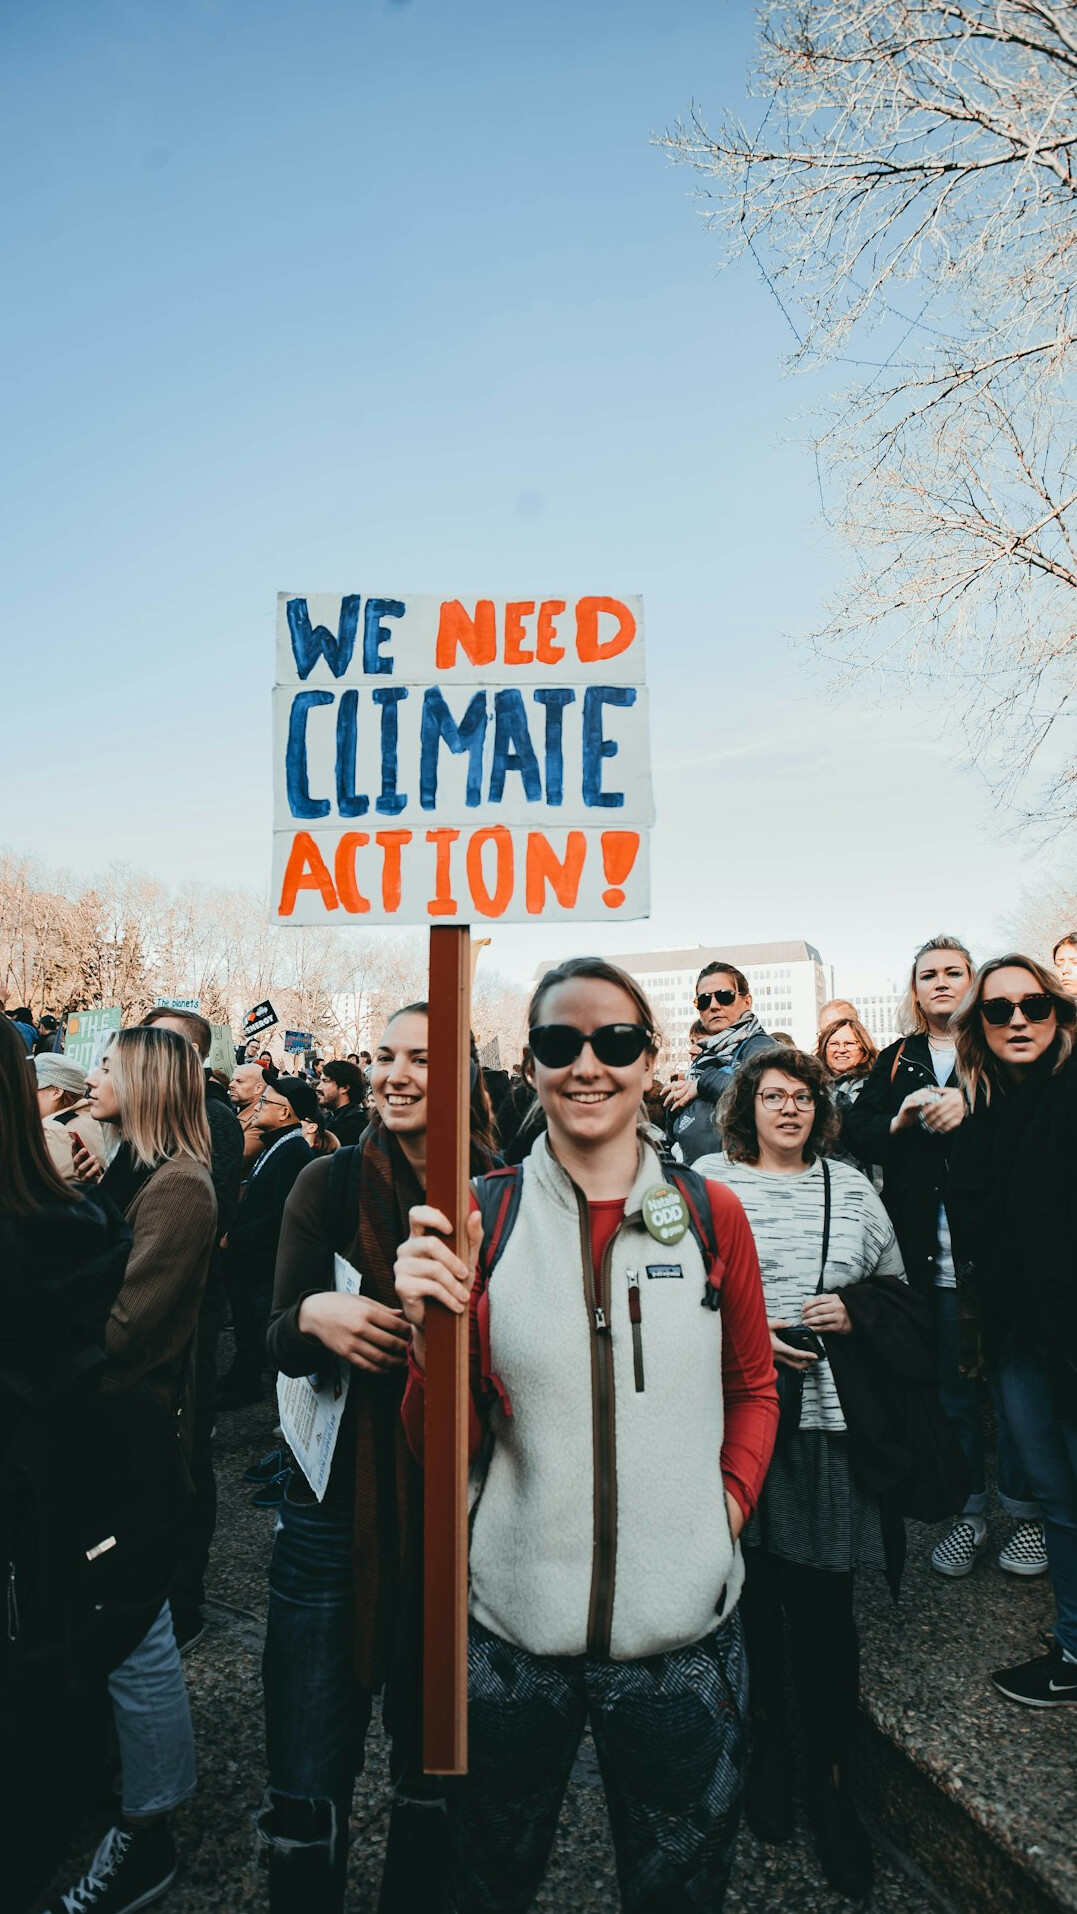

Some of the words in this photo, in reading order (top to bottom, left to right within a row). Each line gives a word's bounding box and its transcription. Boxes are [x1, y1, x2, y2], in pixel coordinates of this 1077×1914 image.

[286, 594, 406, 680] WE
[436, 596, 636, 669] NEED
[286, 685, 637, 819] CLIMATE
[278, 824, 640, 918] ACTION!
[157, 998, 169, 1007] The
[172, 998, 199, 1009] planets
[80, 1013, 110, 1038] THE
[245, 1014, 274, 1034] ENERGY
[67, 1042, 93, 1066] FUT
[651, 1205, 683, 1227] ODD
